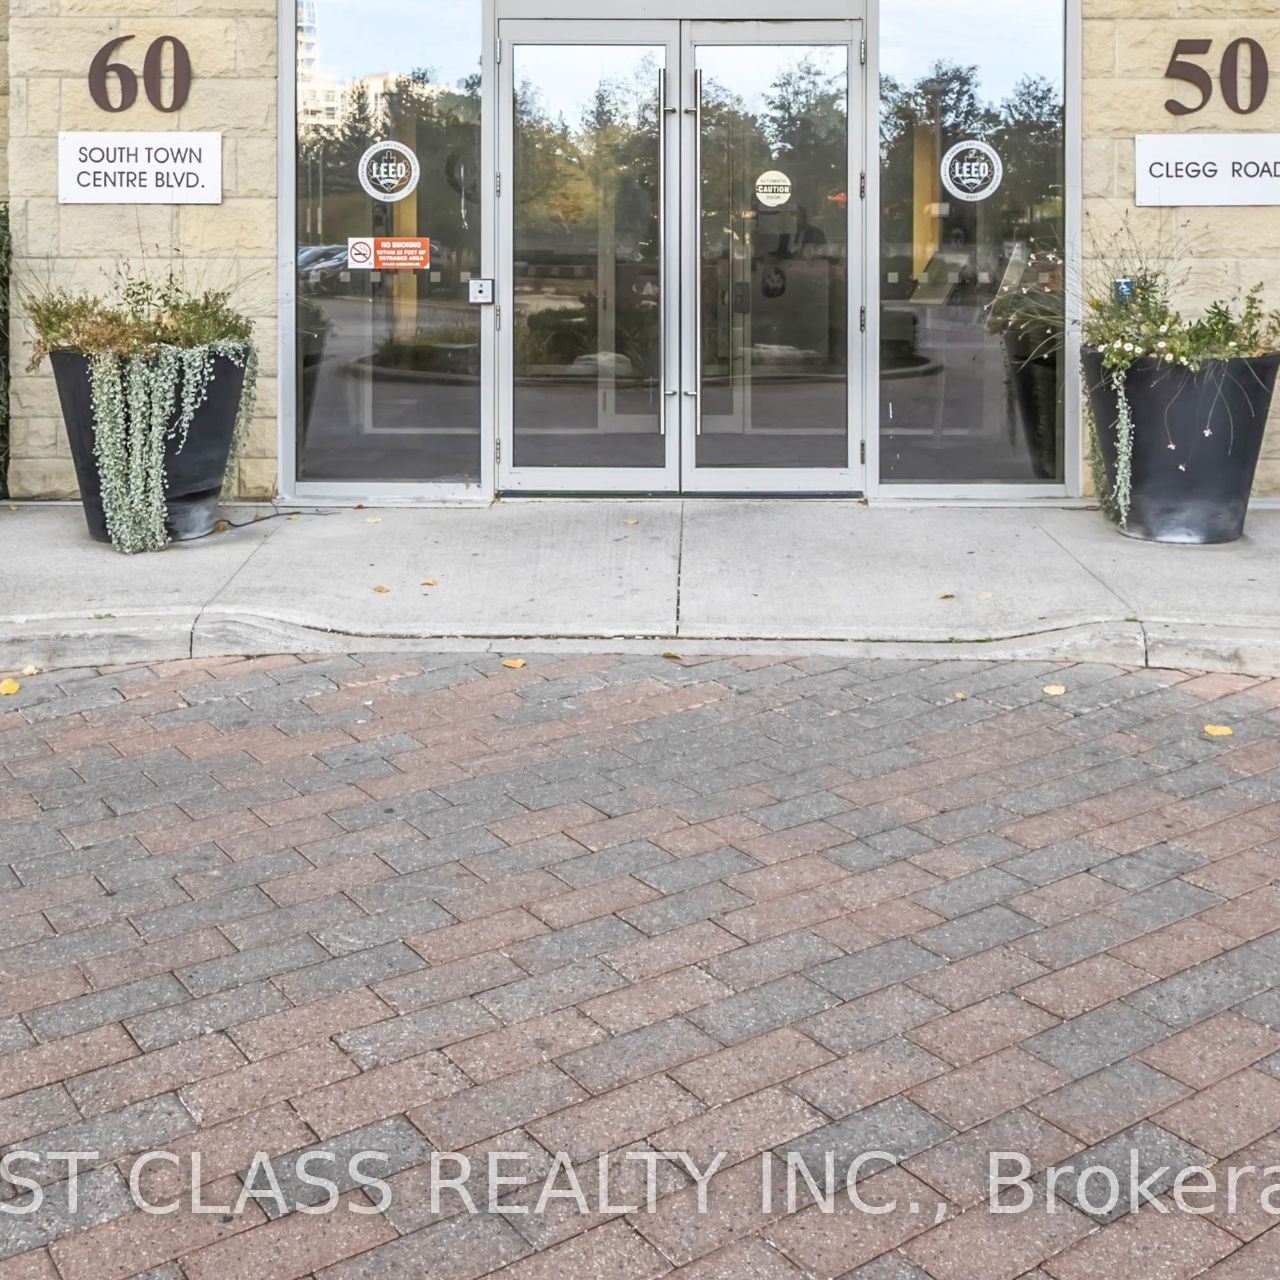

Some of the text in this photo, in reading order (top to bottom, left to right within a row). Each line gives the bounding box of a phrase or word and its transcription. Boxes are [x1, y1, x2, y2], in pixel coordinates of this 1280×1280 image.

[88, 35, 192, 113] 60
[1164, 37, 1269, 115] 50
[78, 147, 202, 163] SOUTH TOWN
[372, 162, 406, 178] LEED
[954, 162, 989, 177] LEED
[1149, 161, 1218, 178] CLEGG
[77, 171, 205, 188] CENTRE BLVD.
[758, 185, 790, 193] CAUTION
